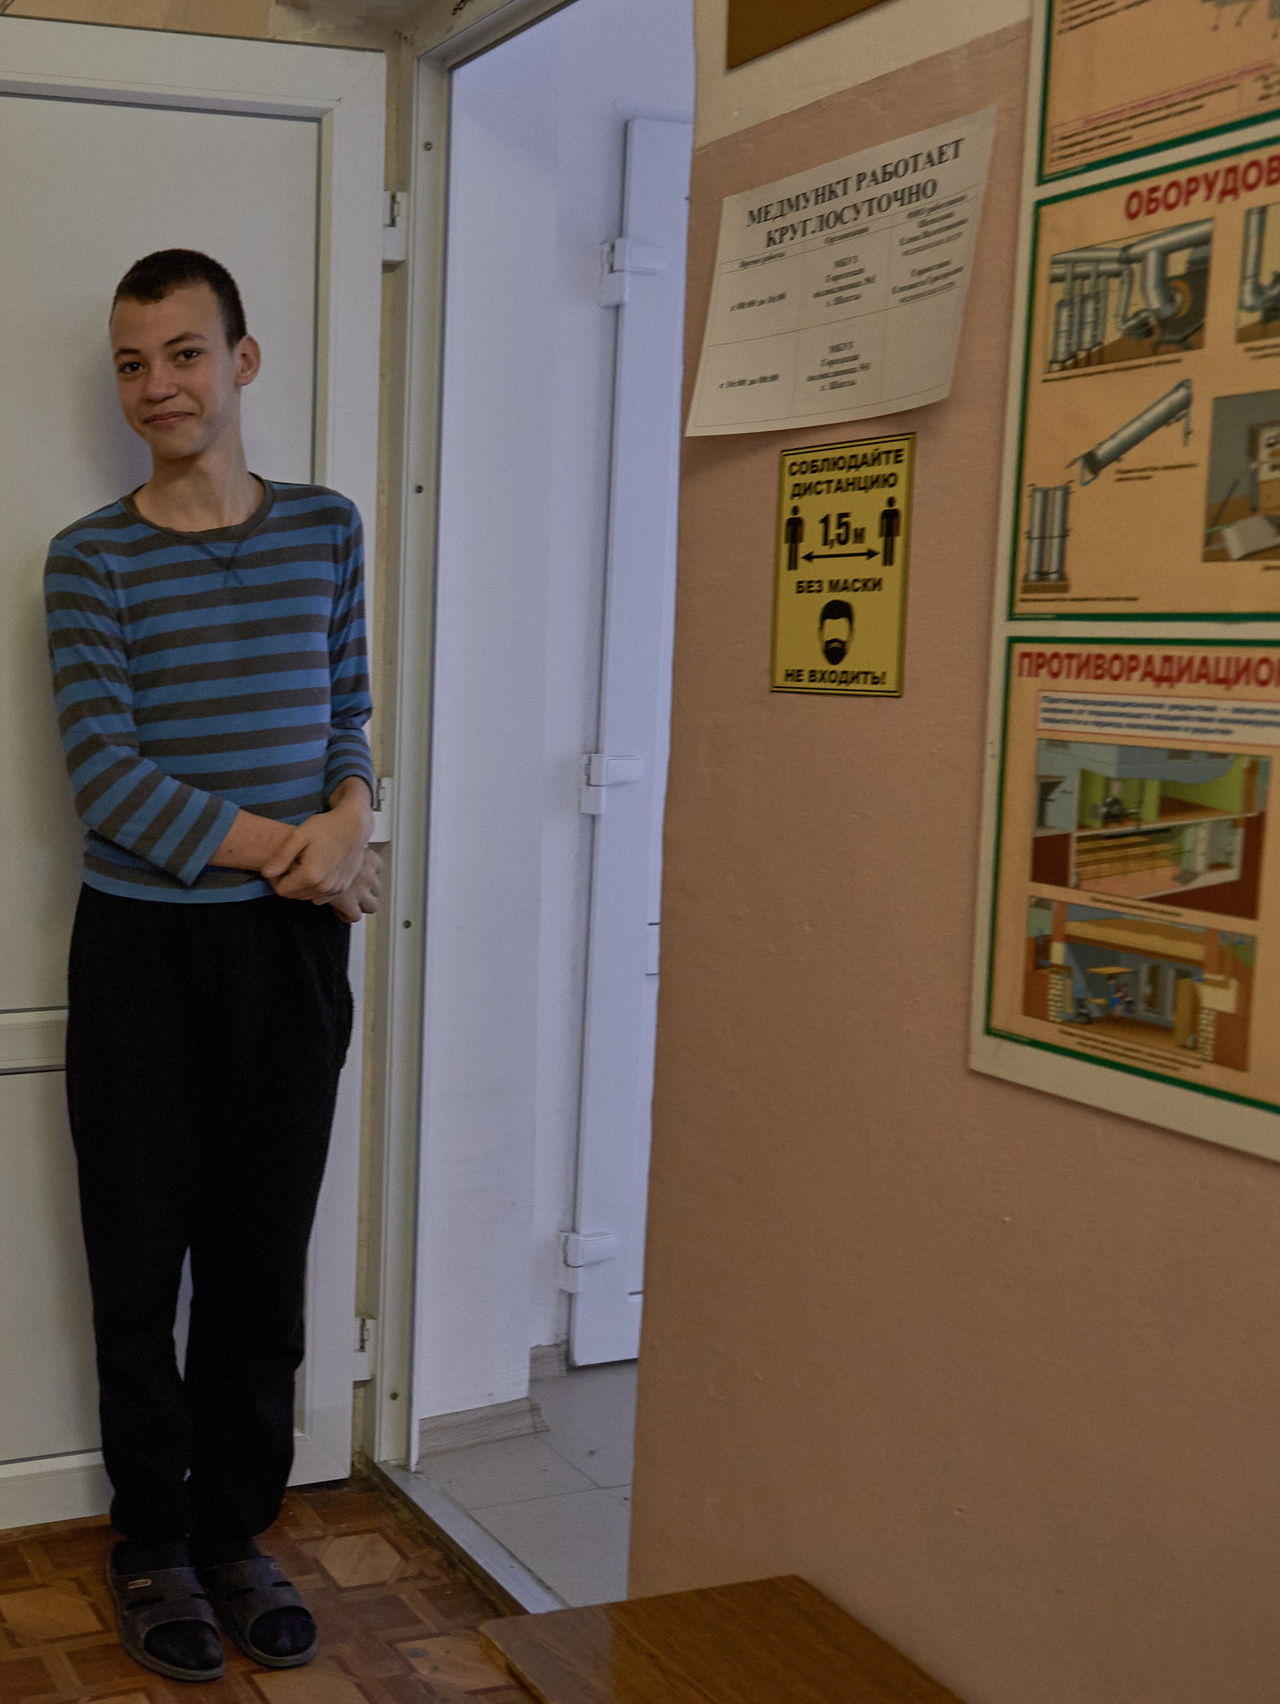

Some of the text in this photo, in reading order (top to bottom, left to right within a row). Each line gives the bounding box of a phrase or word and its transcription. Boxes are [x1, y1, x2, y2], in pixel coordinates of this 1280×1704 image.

[746, 176, 852, 228] МЕДМУНКТ
[855, 138, 965, 192] РАБОТАЕТ
[1124, 154, 1280, 221] ОБОРУДОВ
[765, 178, 938, 248] КРУГЛОСУТОЧНО
[788, 447, 906, 477] СОБЛЮДАЙТЕ
[789, 472, 899, 500] ДИСТАНЦИЮ
[819, 511, 852, 549] 1,5
[795, 577, 884, 595] БЕЗ МАСКИ
[783, 668, 888, 687] НЕ ВХОДИТЬ!
[1018, 652, 1280, 691] ПРОТИВОРАДИАЦИО
